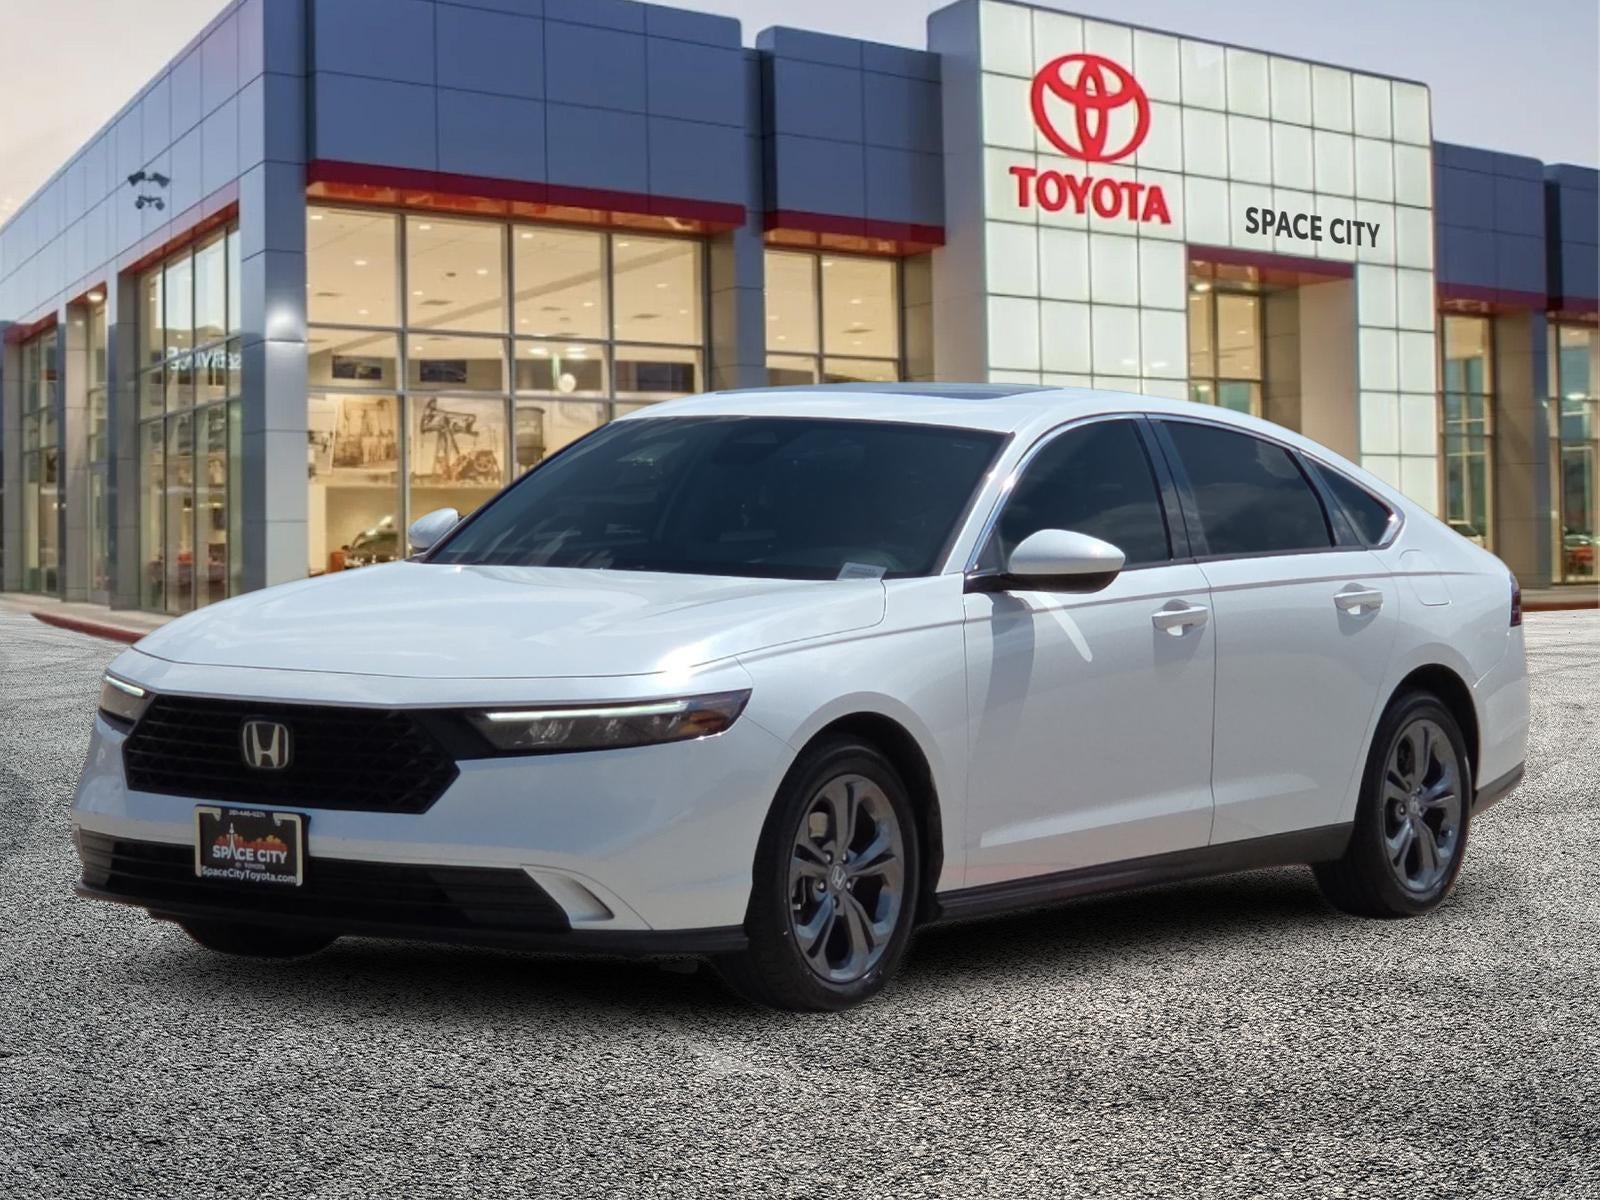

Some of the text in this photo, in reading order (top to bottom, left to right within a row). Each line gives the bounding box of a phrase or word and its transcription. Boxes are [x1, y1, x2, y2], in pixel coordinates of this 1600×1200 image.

[1009, 166, 1172, 225] TOYOTA
[1245, 206, 1381, 248] SPACE CITY
[212, 843, 287, 864] SPACE CITY
[202, 865, 297, 884] SpaceCityToyota.com
